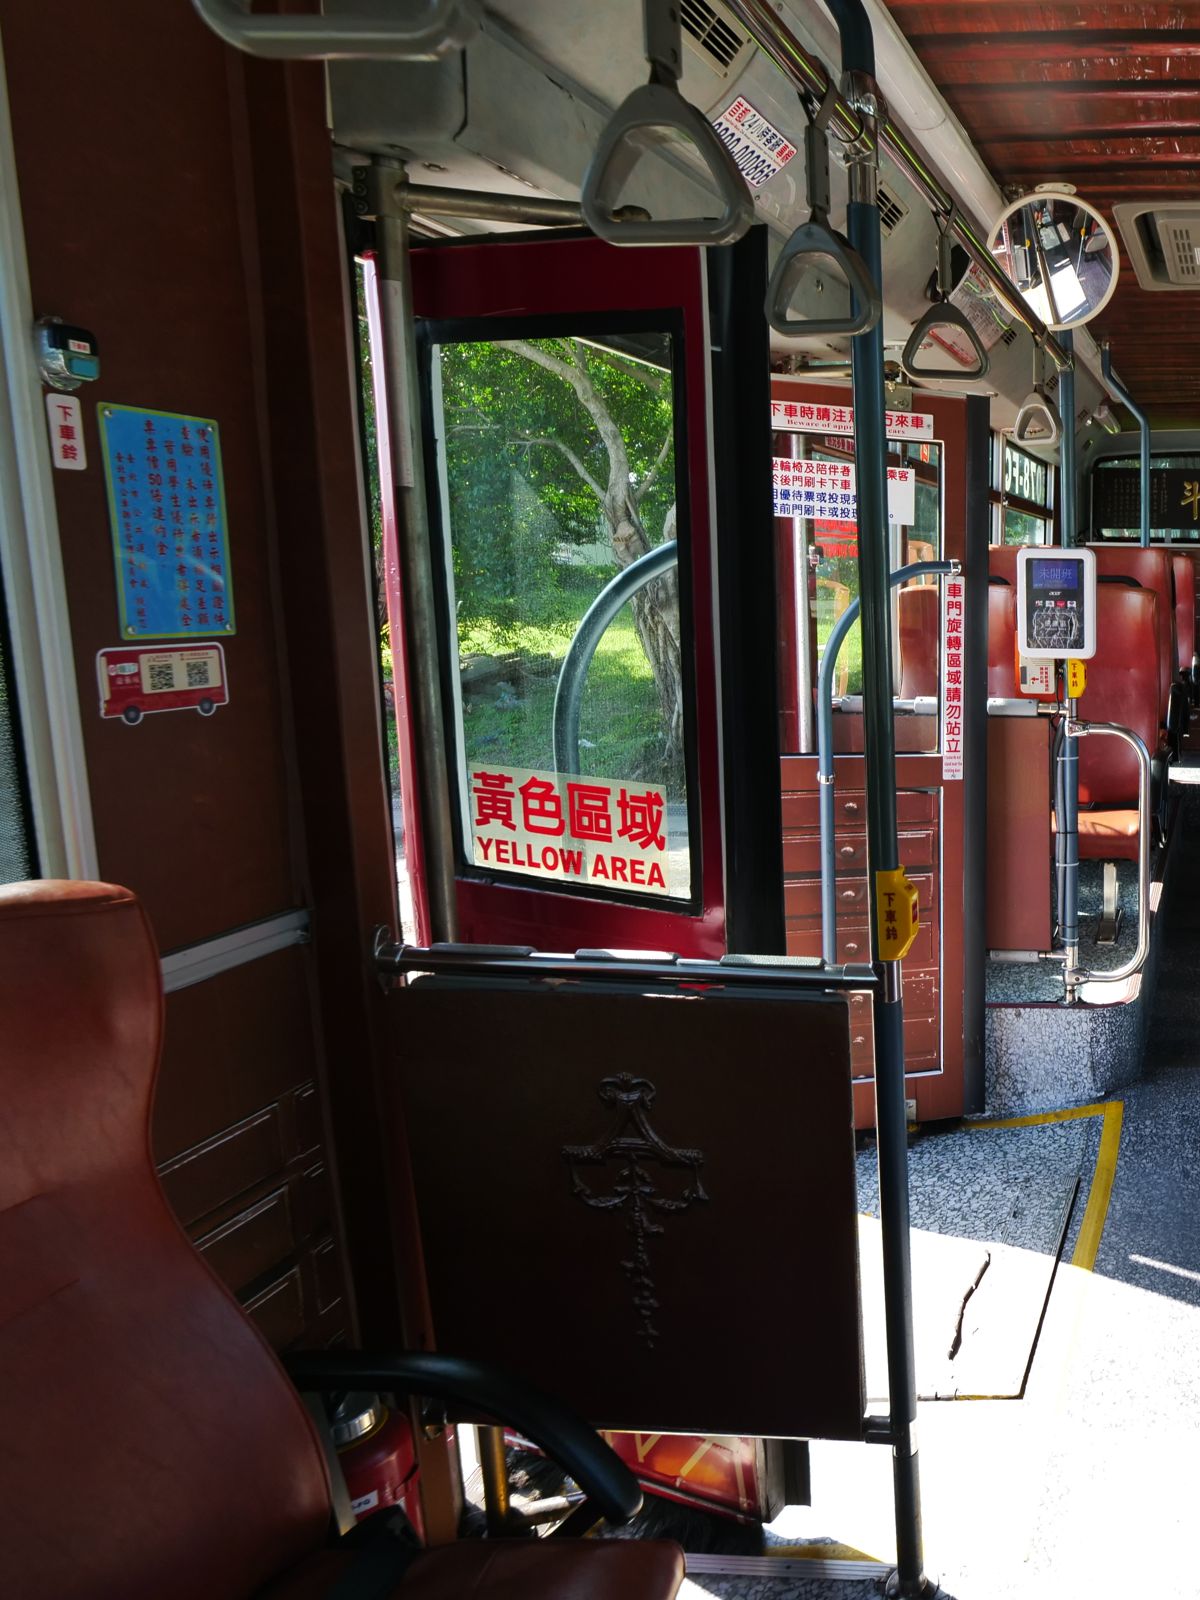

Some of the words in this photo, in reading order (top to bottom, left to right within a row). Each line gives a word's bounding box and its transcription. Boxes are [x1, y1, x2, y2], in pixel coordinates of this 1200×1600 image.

[56, 404, 77, 461] 下車鈴
[947, 583, 962, 753] 車門旋轉區域請勿站立
[473, 771, 666, 851] 黃色區域
[476, 836, 583, 875] YELLOW
[592, 853, 666, 888] AREA
[883, 892, 898, 941] 下車鈴
